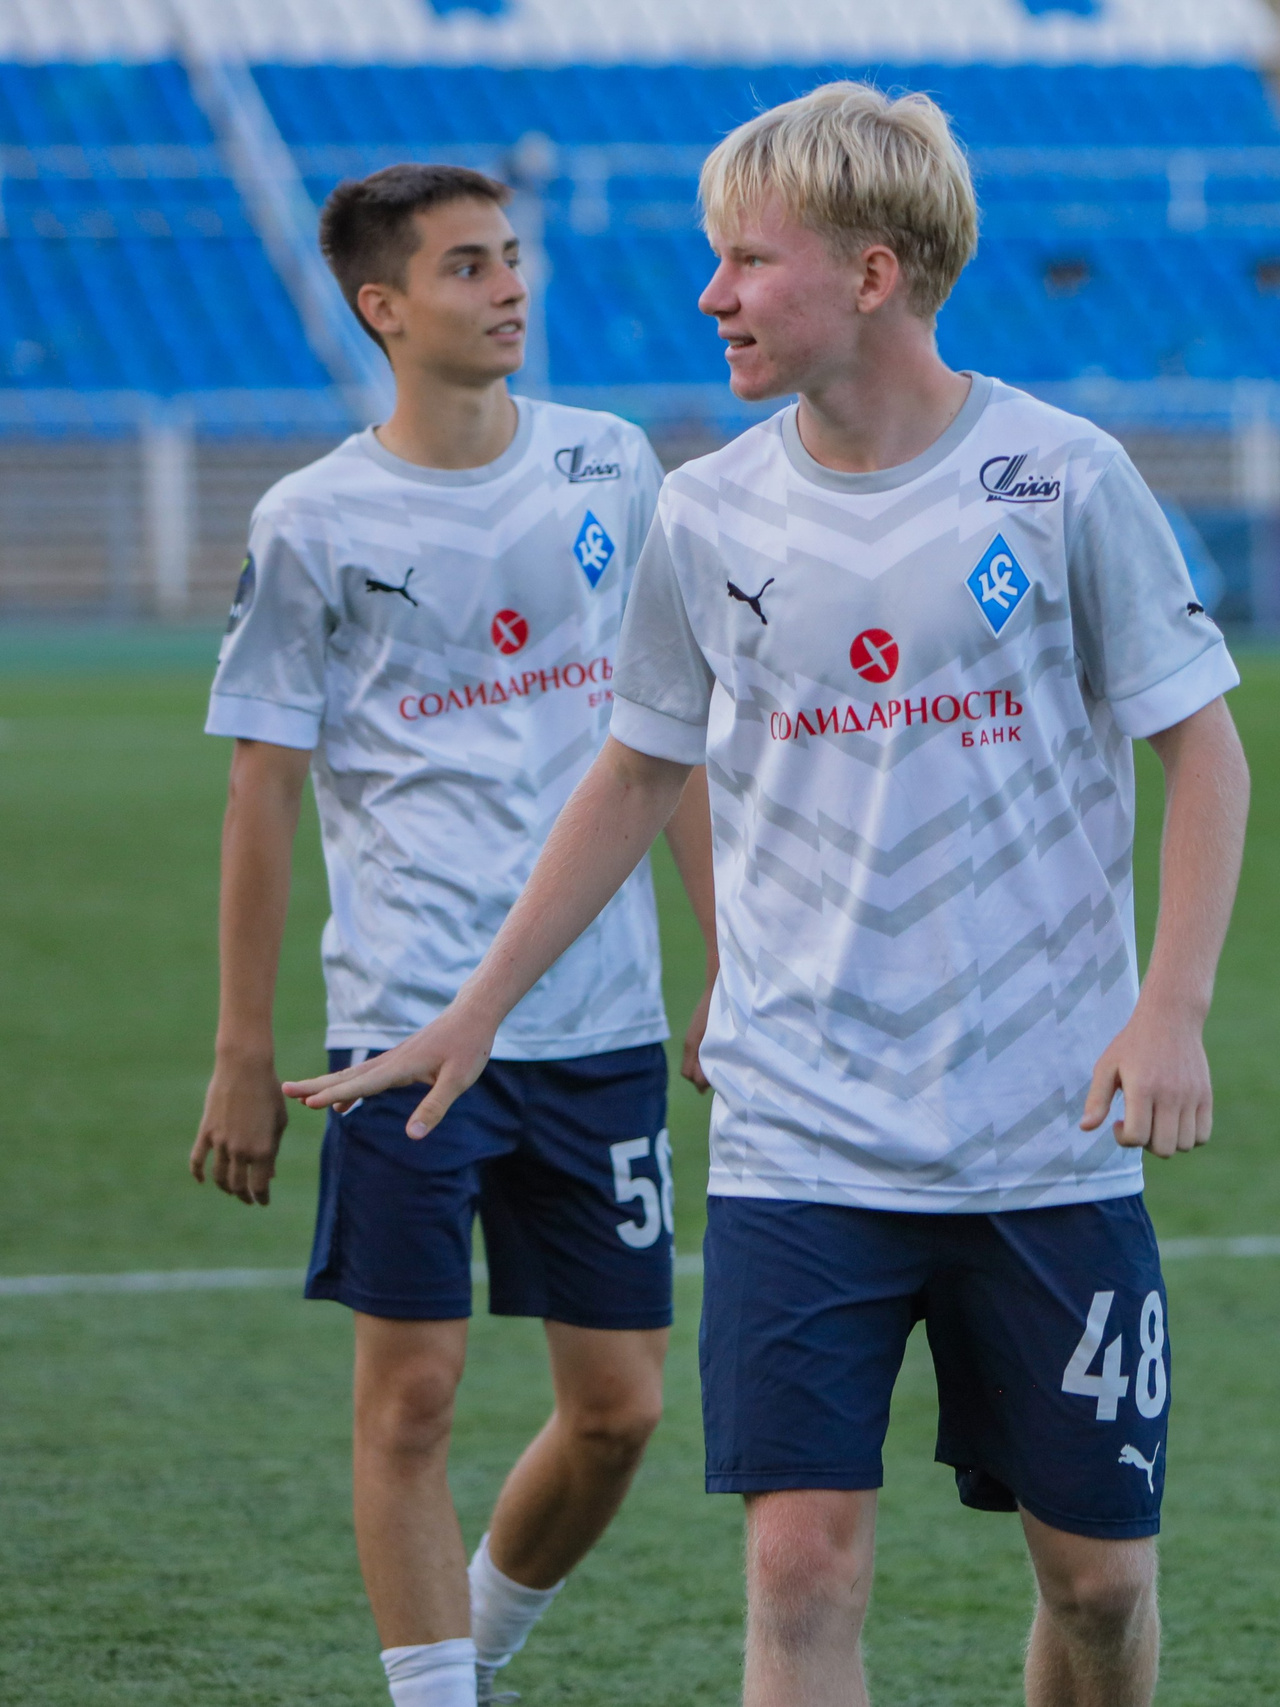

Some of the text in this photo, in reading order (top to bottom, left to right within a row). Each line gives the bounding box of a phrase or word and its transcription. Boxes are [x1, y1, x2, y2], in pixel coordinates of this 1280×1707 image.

[770, 689, 1023, 740] СОЛИДАРНОСТЬ
[961, 725, 1021, 748] БАНК
[1061, 1290, 1166, 1421] 48
